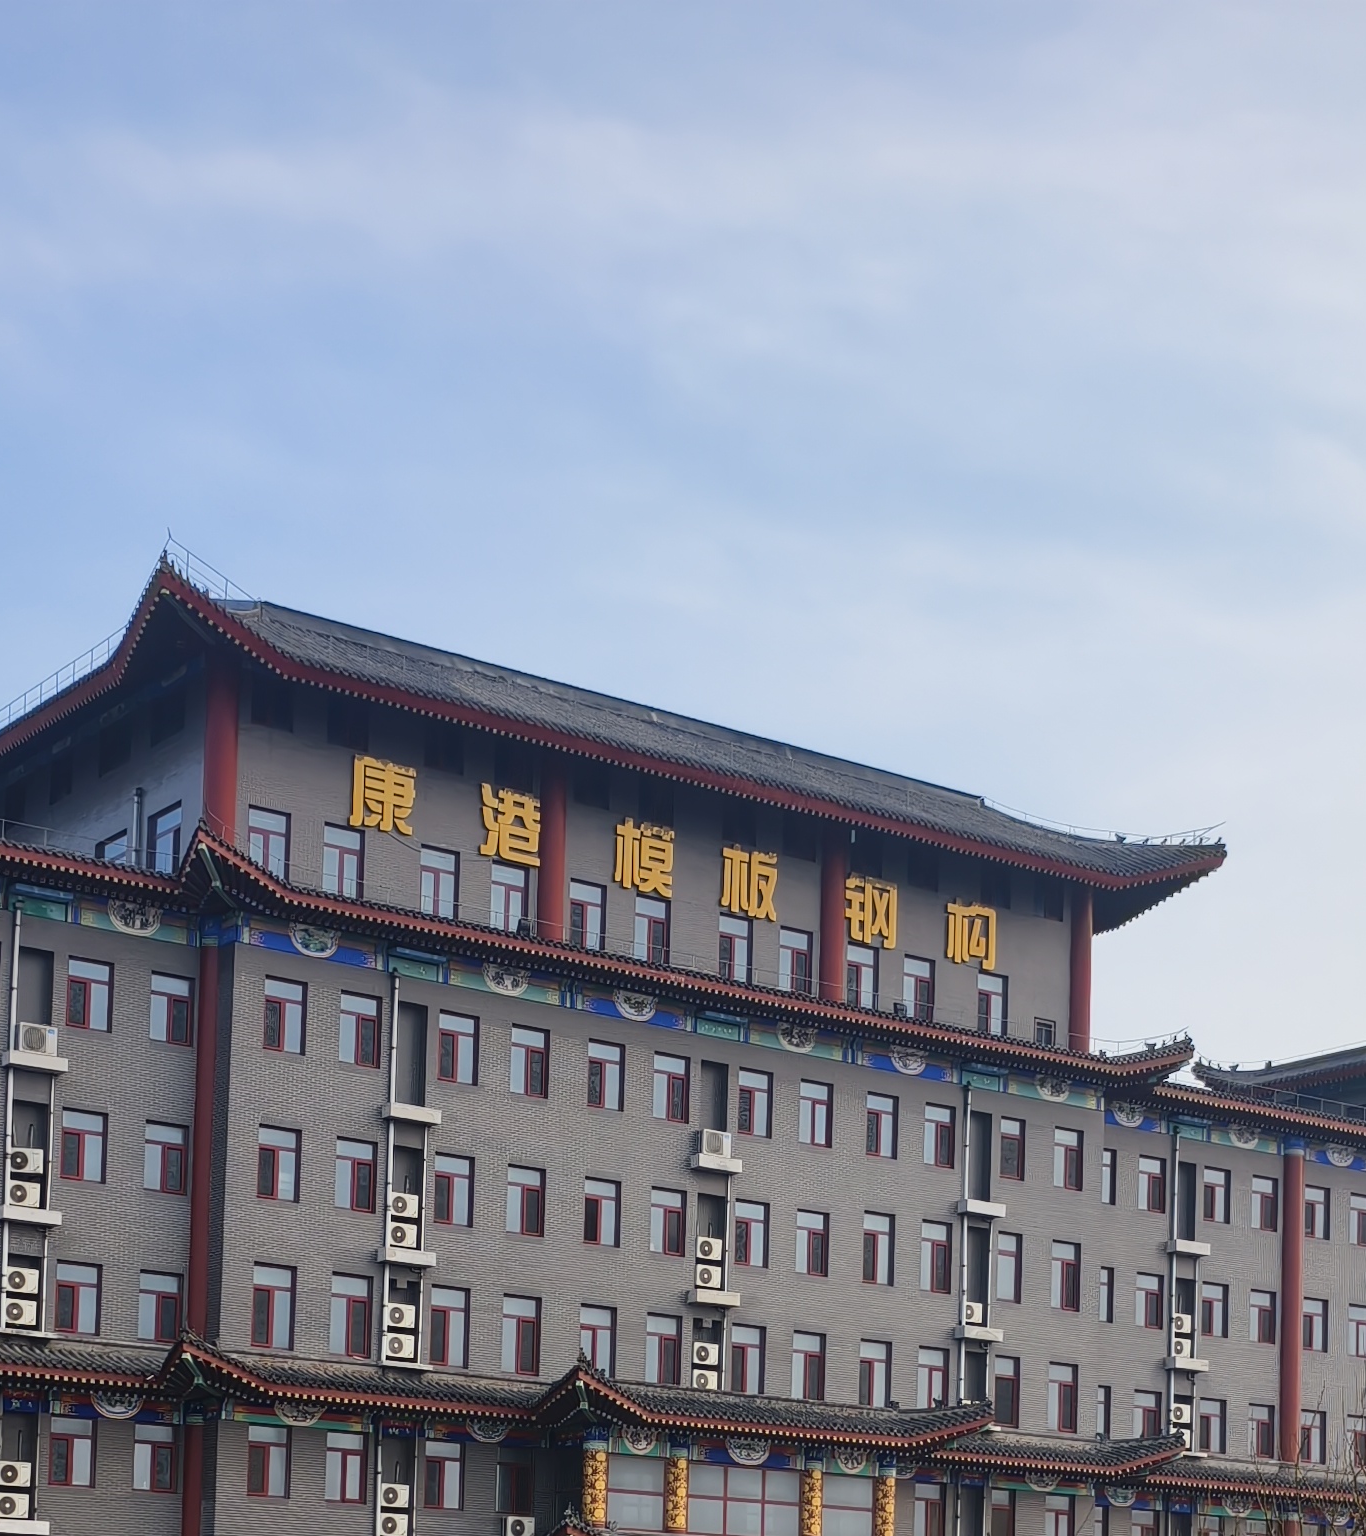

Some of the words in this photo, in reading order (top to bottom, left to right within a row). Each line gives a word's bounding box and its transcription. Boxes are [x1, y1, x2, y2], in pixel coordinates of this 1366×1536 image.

[349, 754, 997, 971] 康港模板钢构
